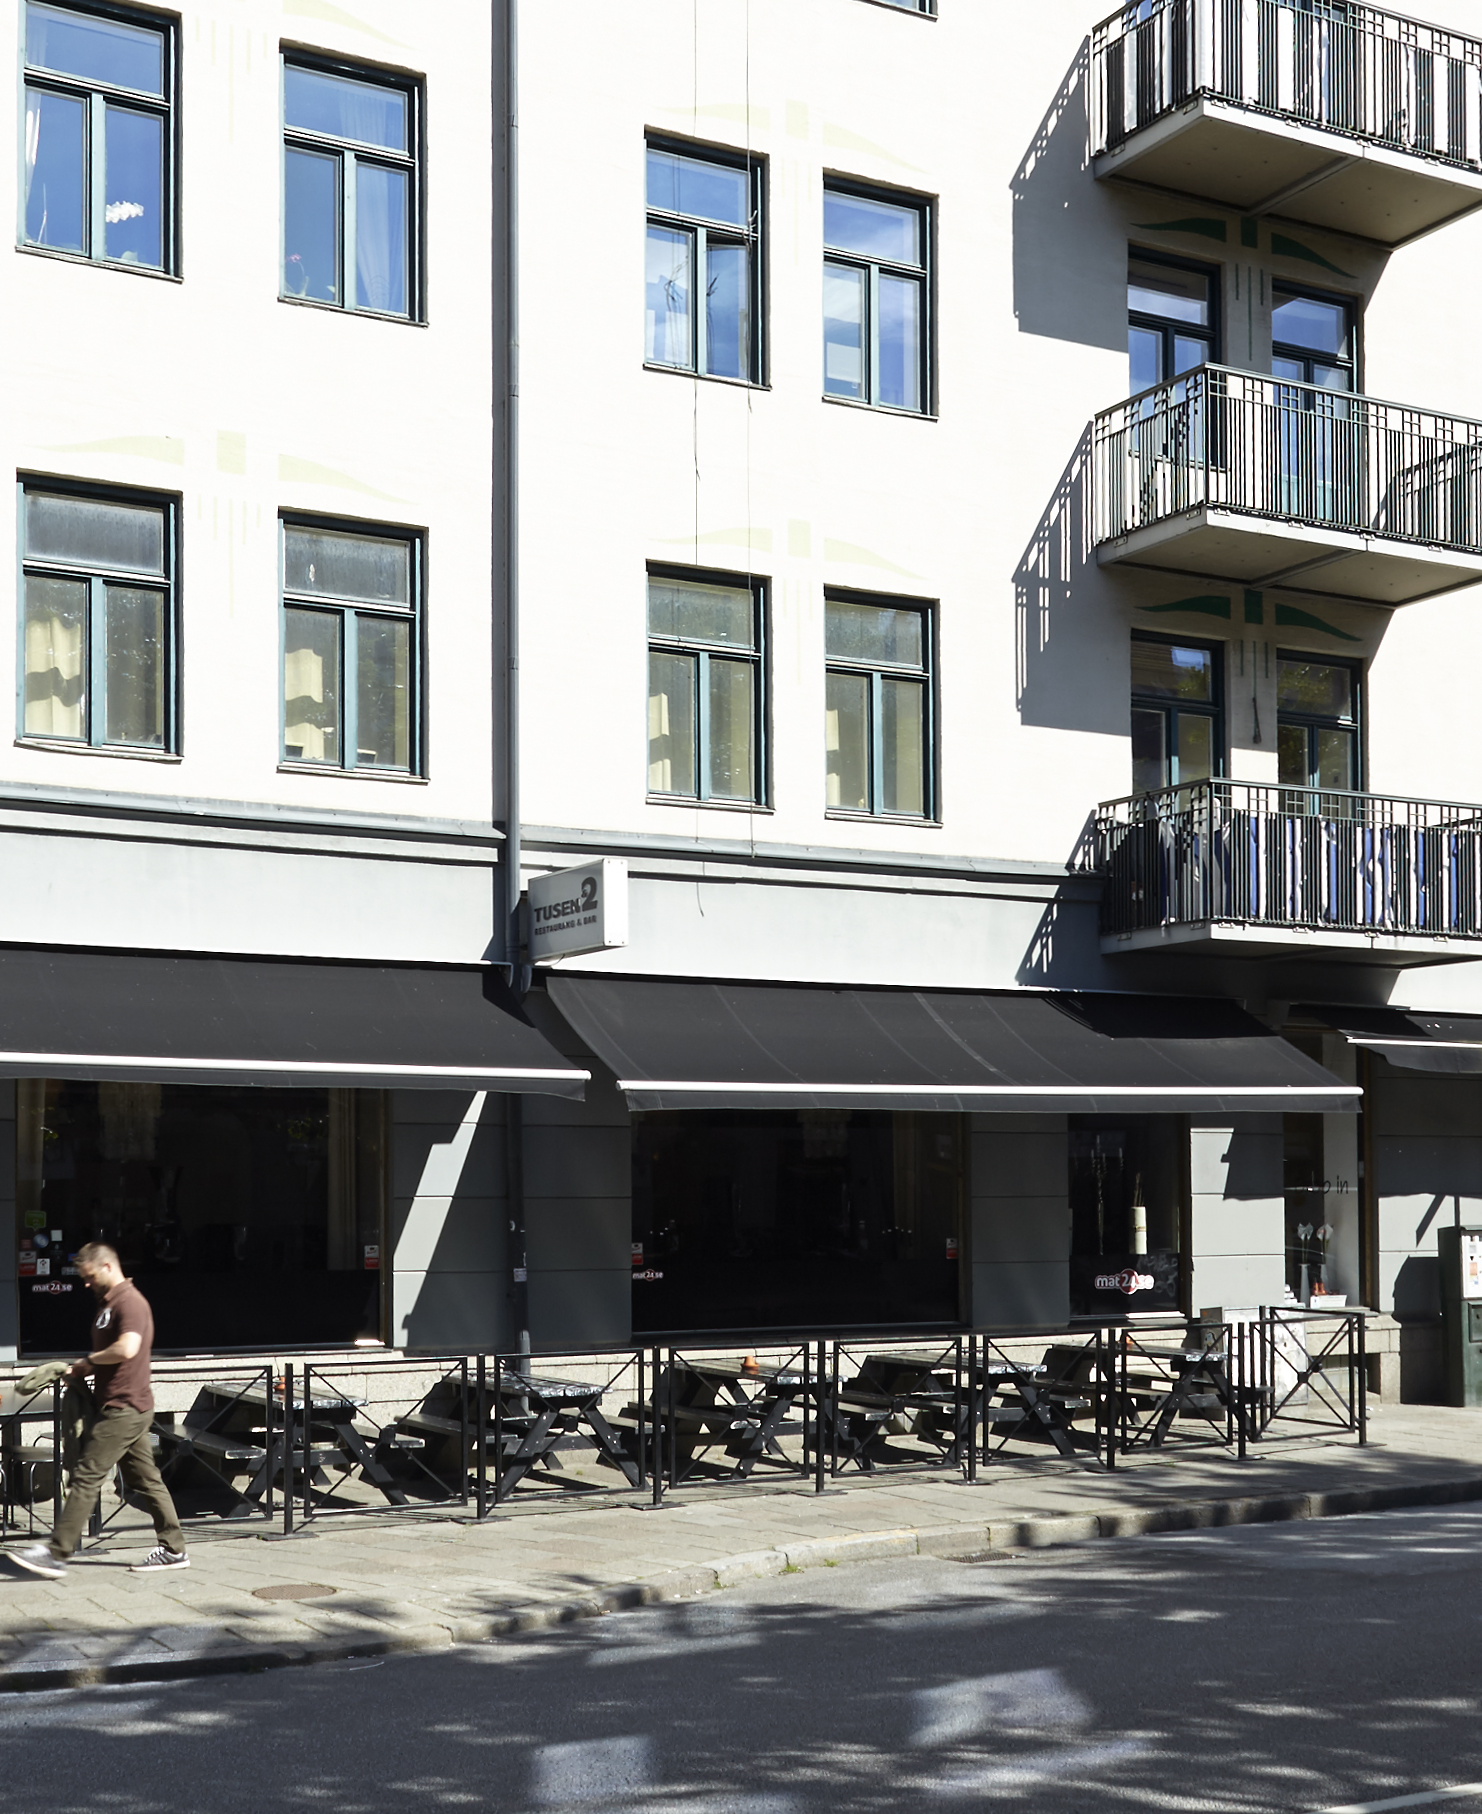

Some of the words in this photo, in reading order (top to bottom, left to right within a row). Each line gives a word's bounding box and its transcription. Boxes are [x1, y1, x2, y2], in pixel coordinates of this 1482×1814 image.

[534, 898, 580, 923] TUSEN
[581, 876, 598, 912] 2
[534, 920, 575, 936] RESTAURANG
[583, 915, 597, 924] BAR
